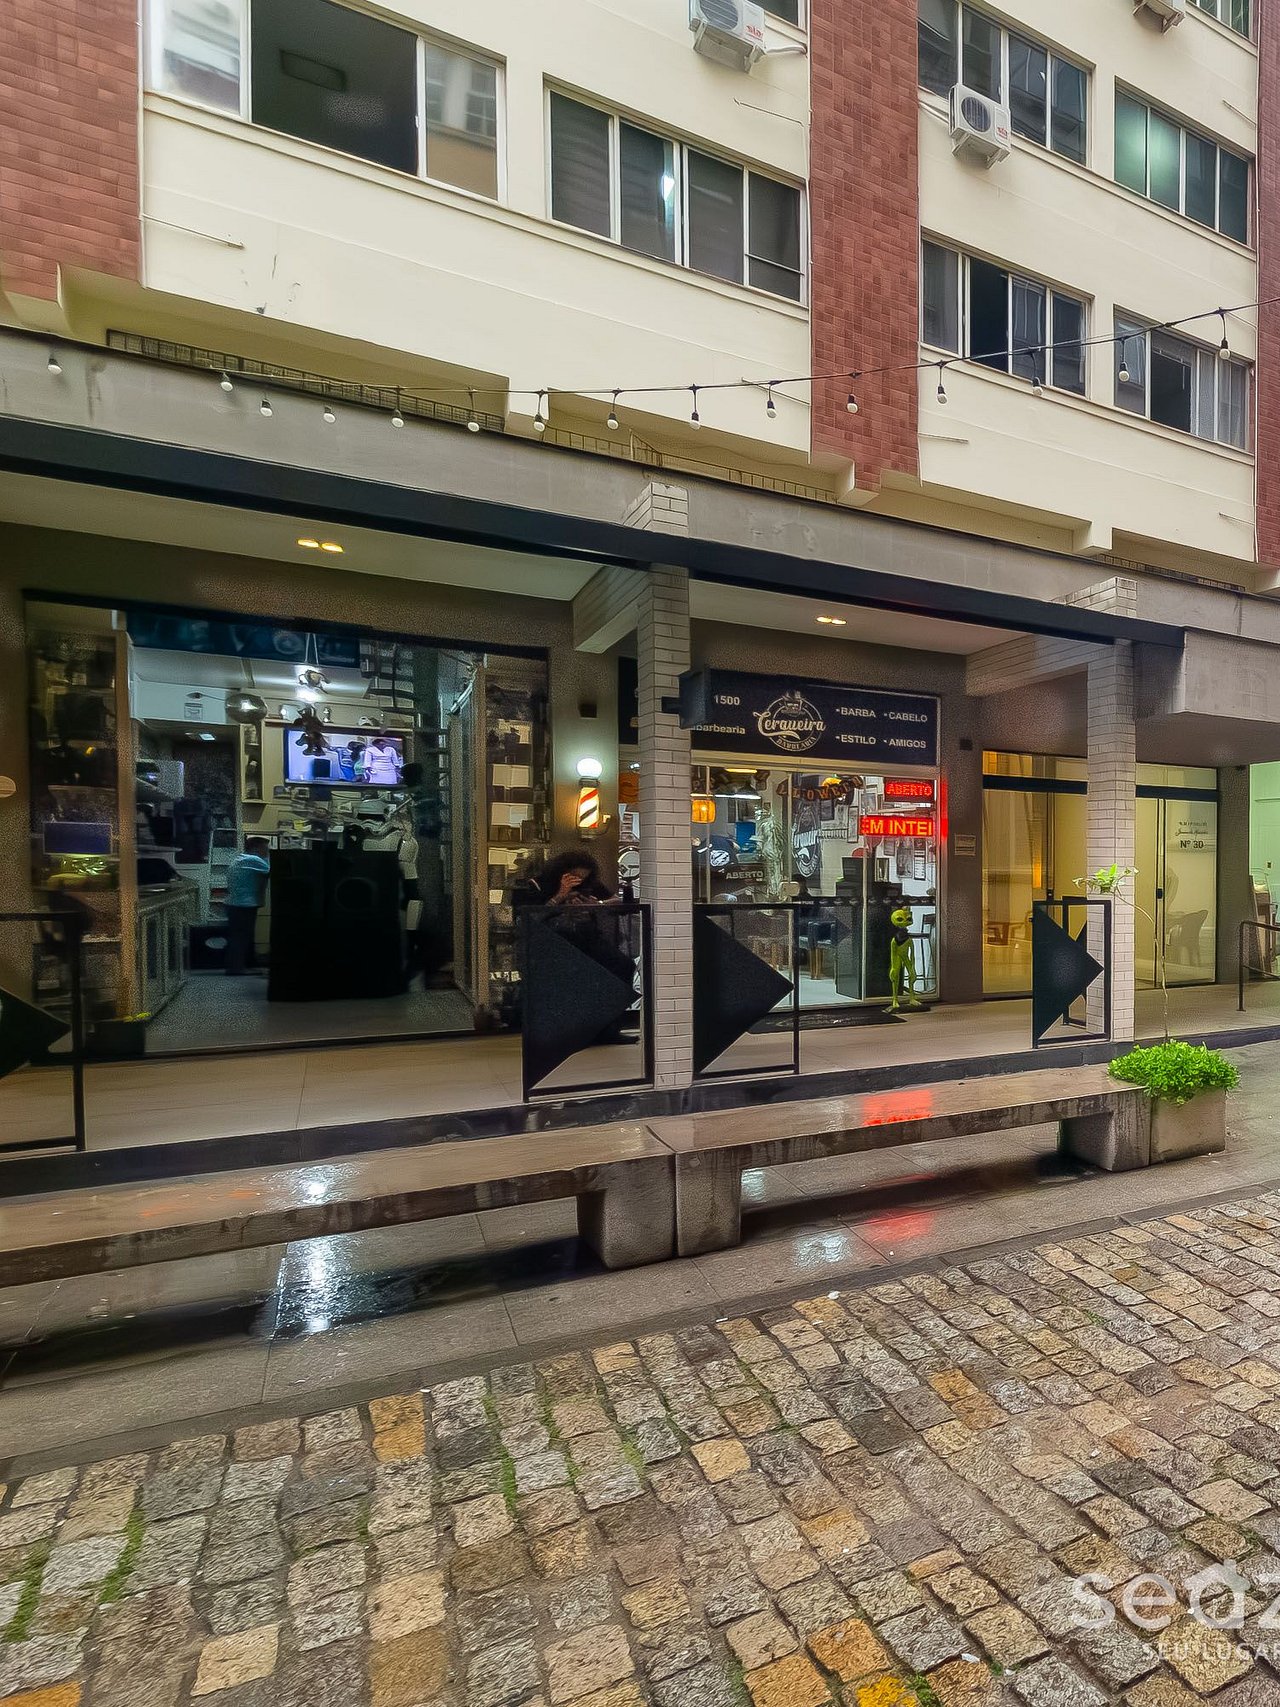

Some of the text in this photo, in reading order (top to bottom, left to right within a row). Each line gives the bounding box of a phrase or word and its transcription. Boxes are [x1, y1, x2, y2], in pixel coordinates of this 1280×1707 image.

[841, 706, 928, 723] BARBA CABELO
[841, 734, 927, 749] ESTILO AMIGOS
[885, 782, 933, 797] ABERTO
[1193, 839, 1204, 849] 30
[725, 870, 764, 880] ABERTO
